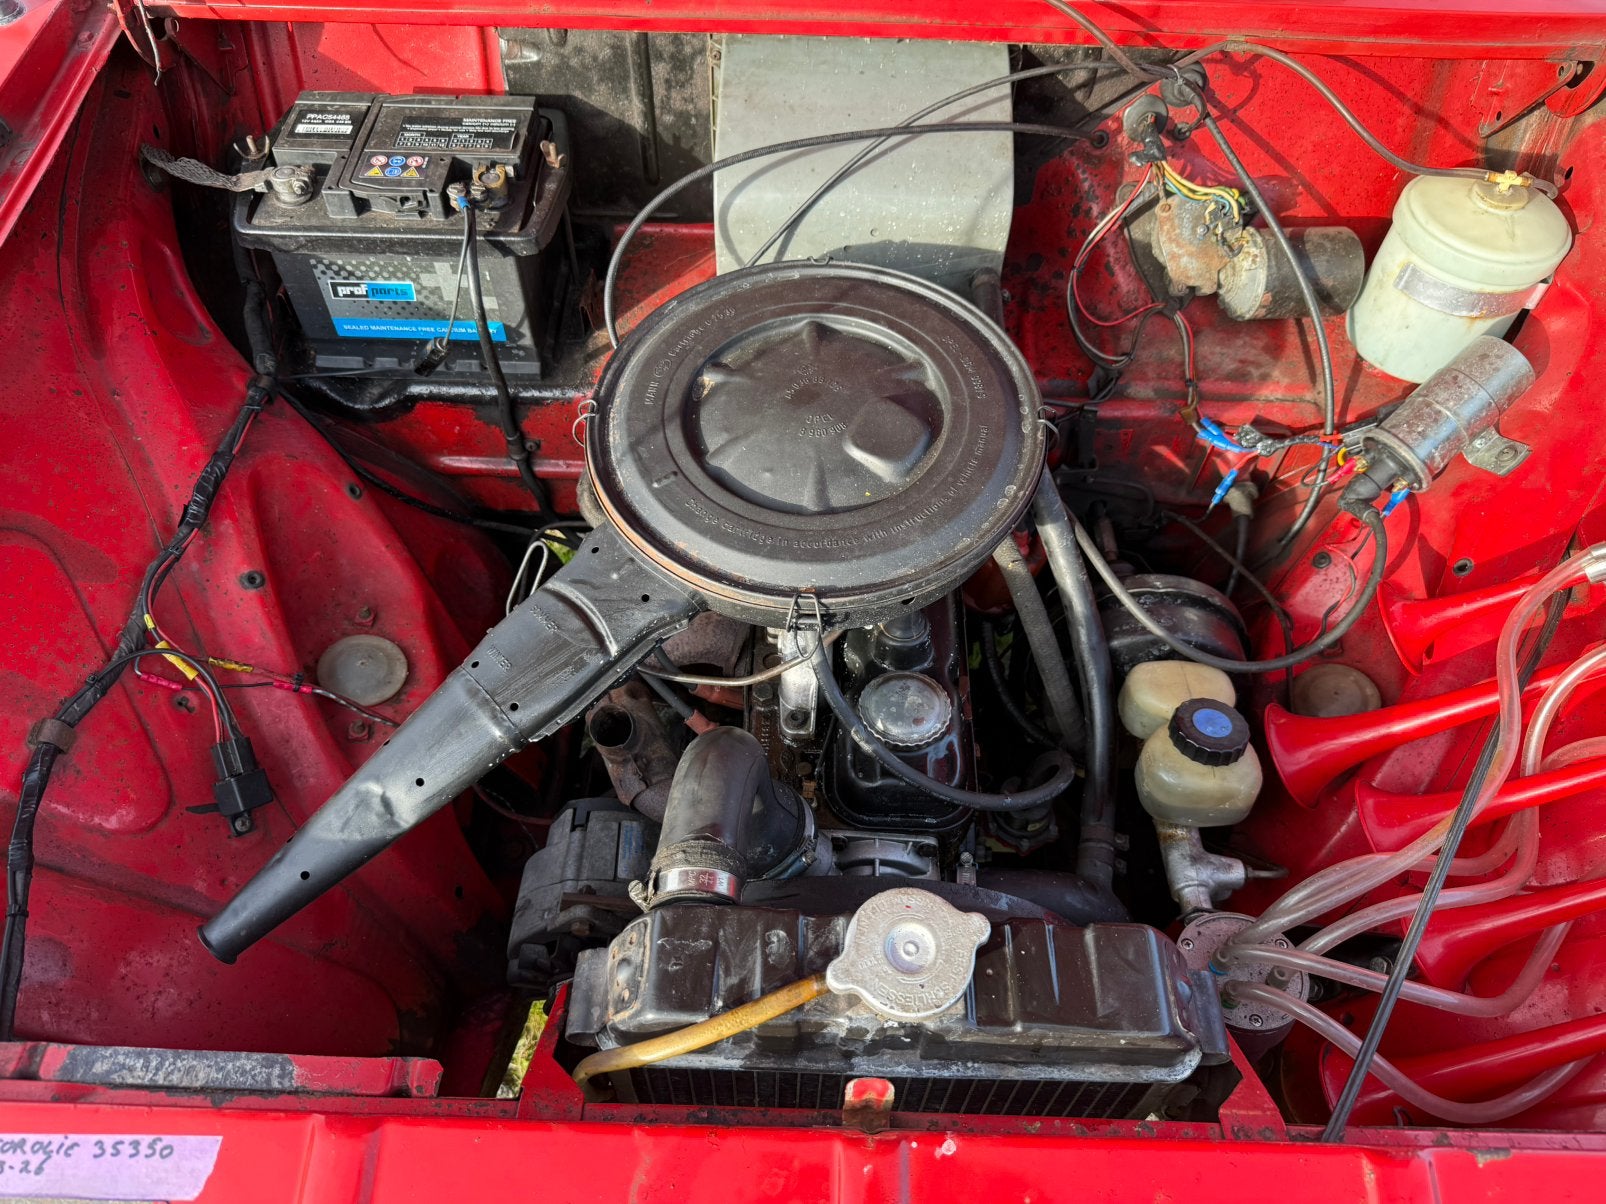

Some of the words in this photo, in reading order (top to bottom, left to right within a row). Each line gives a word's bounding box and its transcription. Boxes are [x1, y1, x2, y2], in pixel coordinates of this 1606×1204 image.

[684, 498, 719, 525] Change
[721, 520, 775, 545] cartridge
[793, 537, 860, 549] accordance
[863, 528, 889, 544] with
[890, 497, 949, 535] instructions
[974, 424, 990, 456] manual
[92, 1137, 175, 1159] 35350
